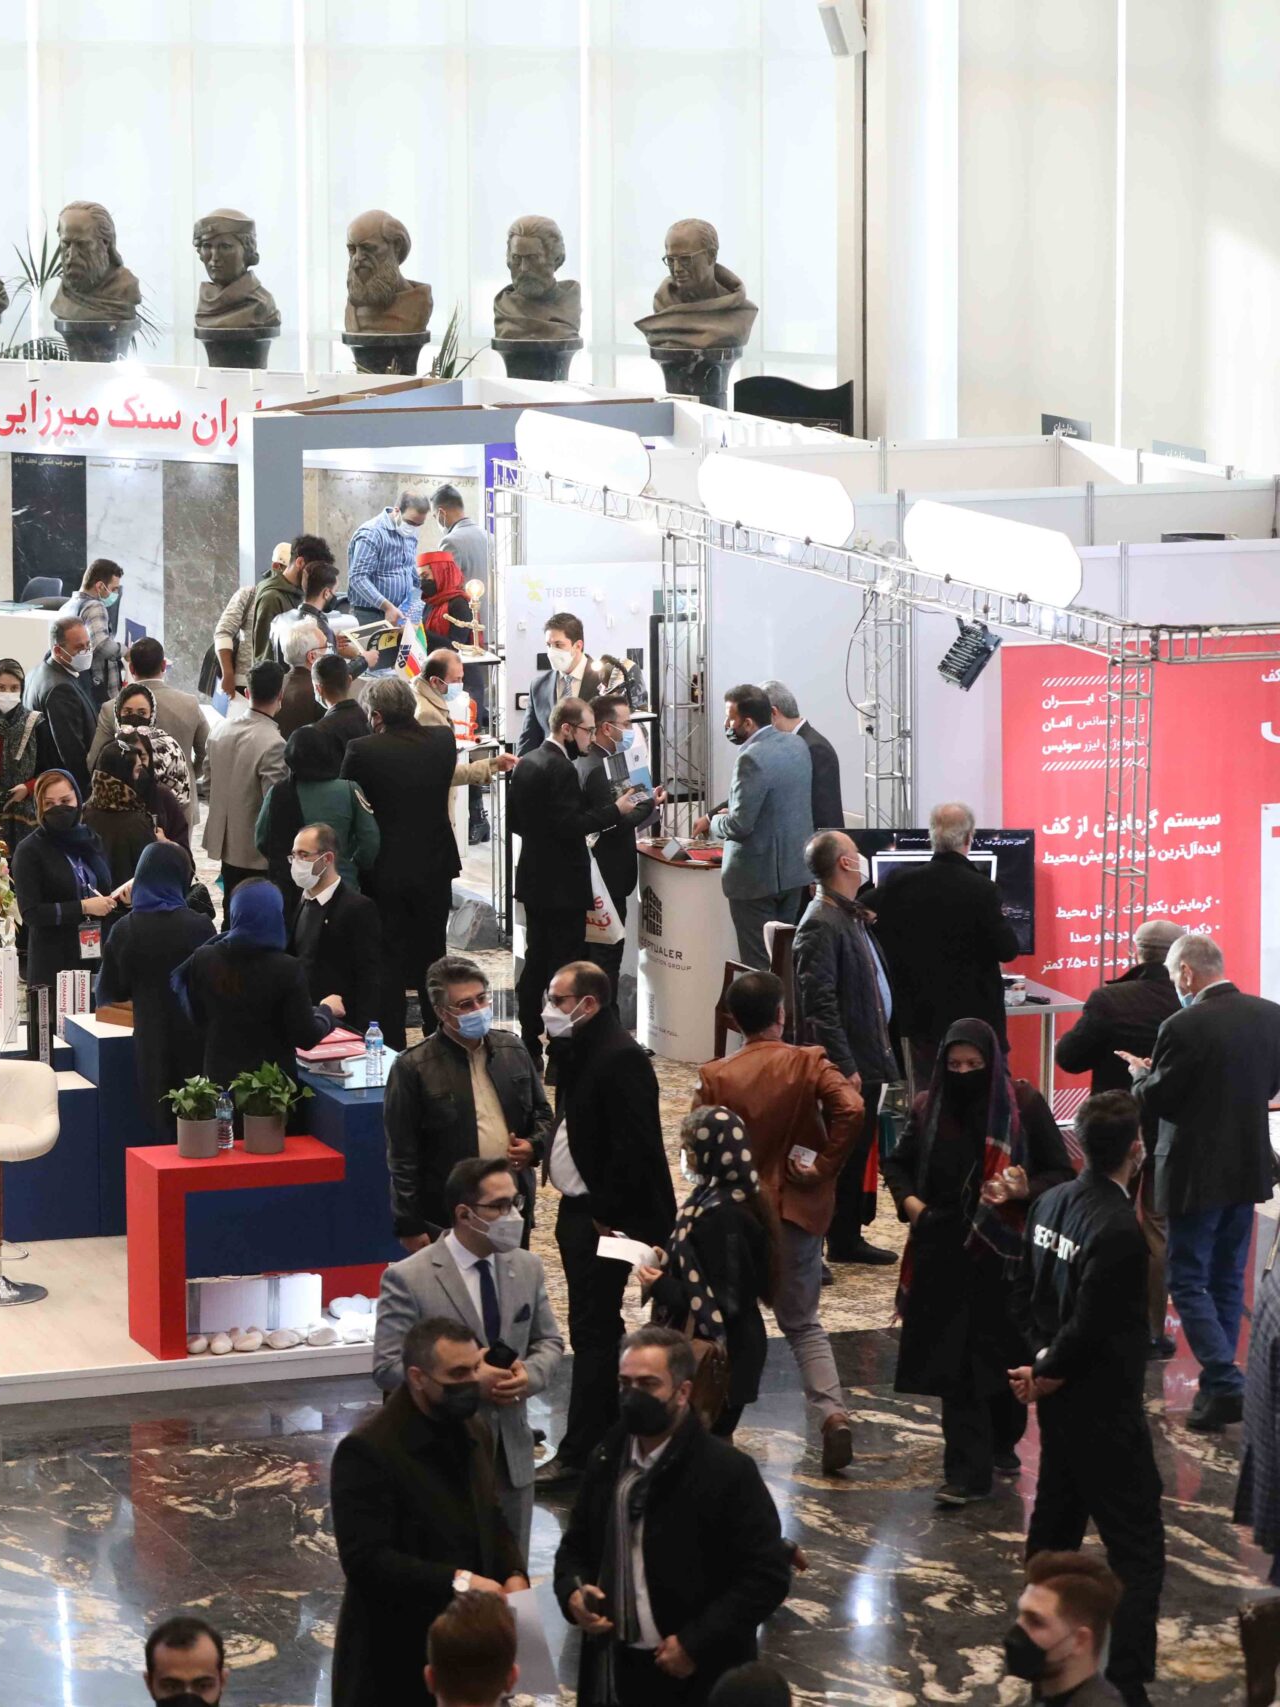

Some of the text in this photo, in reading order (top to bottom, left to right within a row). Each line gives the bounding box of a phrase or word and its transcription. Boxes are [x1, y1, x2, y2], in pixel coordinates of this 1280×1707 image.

[1042, 692, 1094, 709] ایران
[1041, 815, 1072, 835] کف
[1074, 815, 1089, 840] از
[1163, 812, 1221, 835] سیستم
[1042, 850, 1078, 865] محیط
[1055, 906, 1088, 920] محیط
[1122, 899, 1169, 917] یکنوخت
[1170, 895, 1213, 915] گرمایش
[1069, 931, 1092, 943] صدا
[1040, 957, 1065, 975] کمتر
[1033, 1224, 1081, 1264] SECUITY
